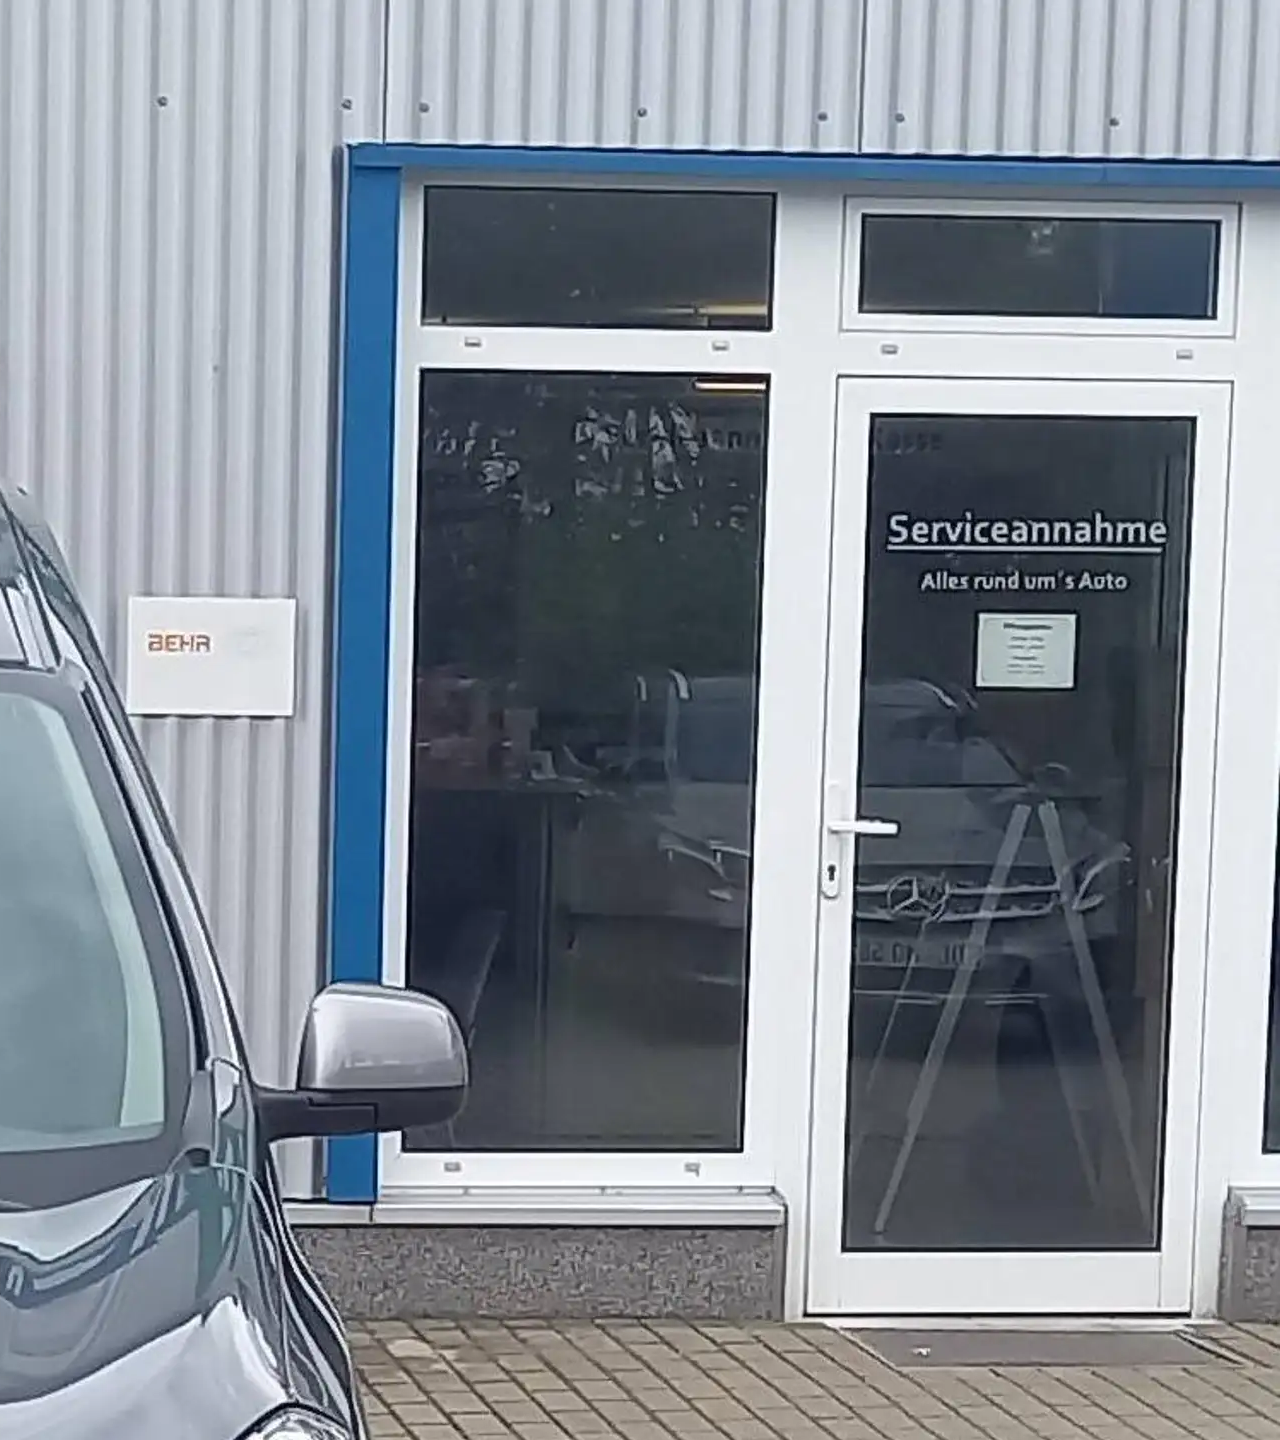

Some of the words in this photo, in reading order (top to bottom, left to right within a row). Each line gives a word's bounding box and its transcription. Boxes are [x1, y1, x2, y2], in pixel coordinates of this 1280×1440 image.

[887, 511, 1167, 544] Serviceannahme
[920, 571, 969, 590] Alles
[973, 570, 1019, 590] rund
[1077, 571, 1128, 590] Auto
[147, 633, 211, 652] BEHR
